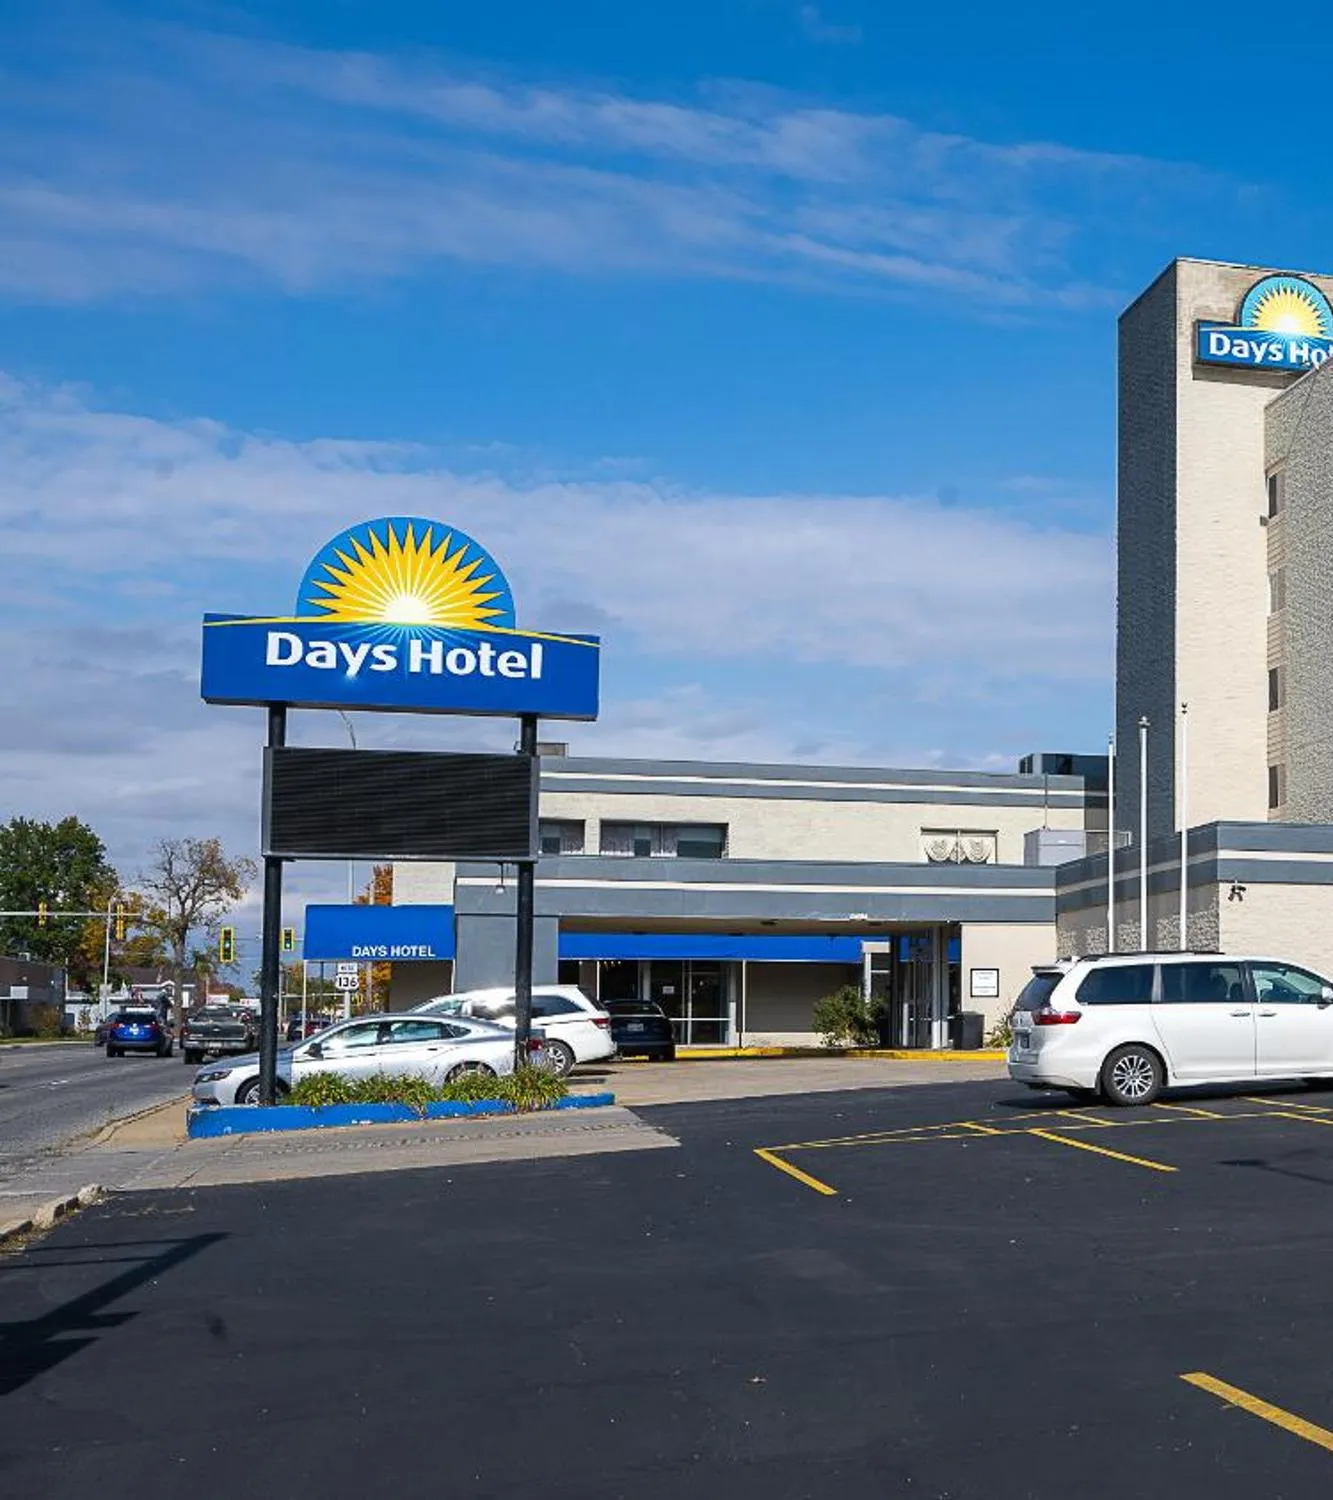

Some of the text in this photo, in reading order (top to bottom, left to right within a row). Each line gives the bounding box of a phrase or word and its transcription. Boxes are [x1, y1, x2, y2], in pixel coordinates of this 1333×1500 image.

[1209, 332, 1284, 363] Days
[266, 631, 543, 679] Days Hotel
[352, 945, 436, 957] DAYS HOTEL
[338, 977, 358, 987] 136
